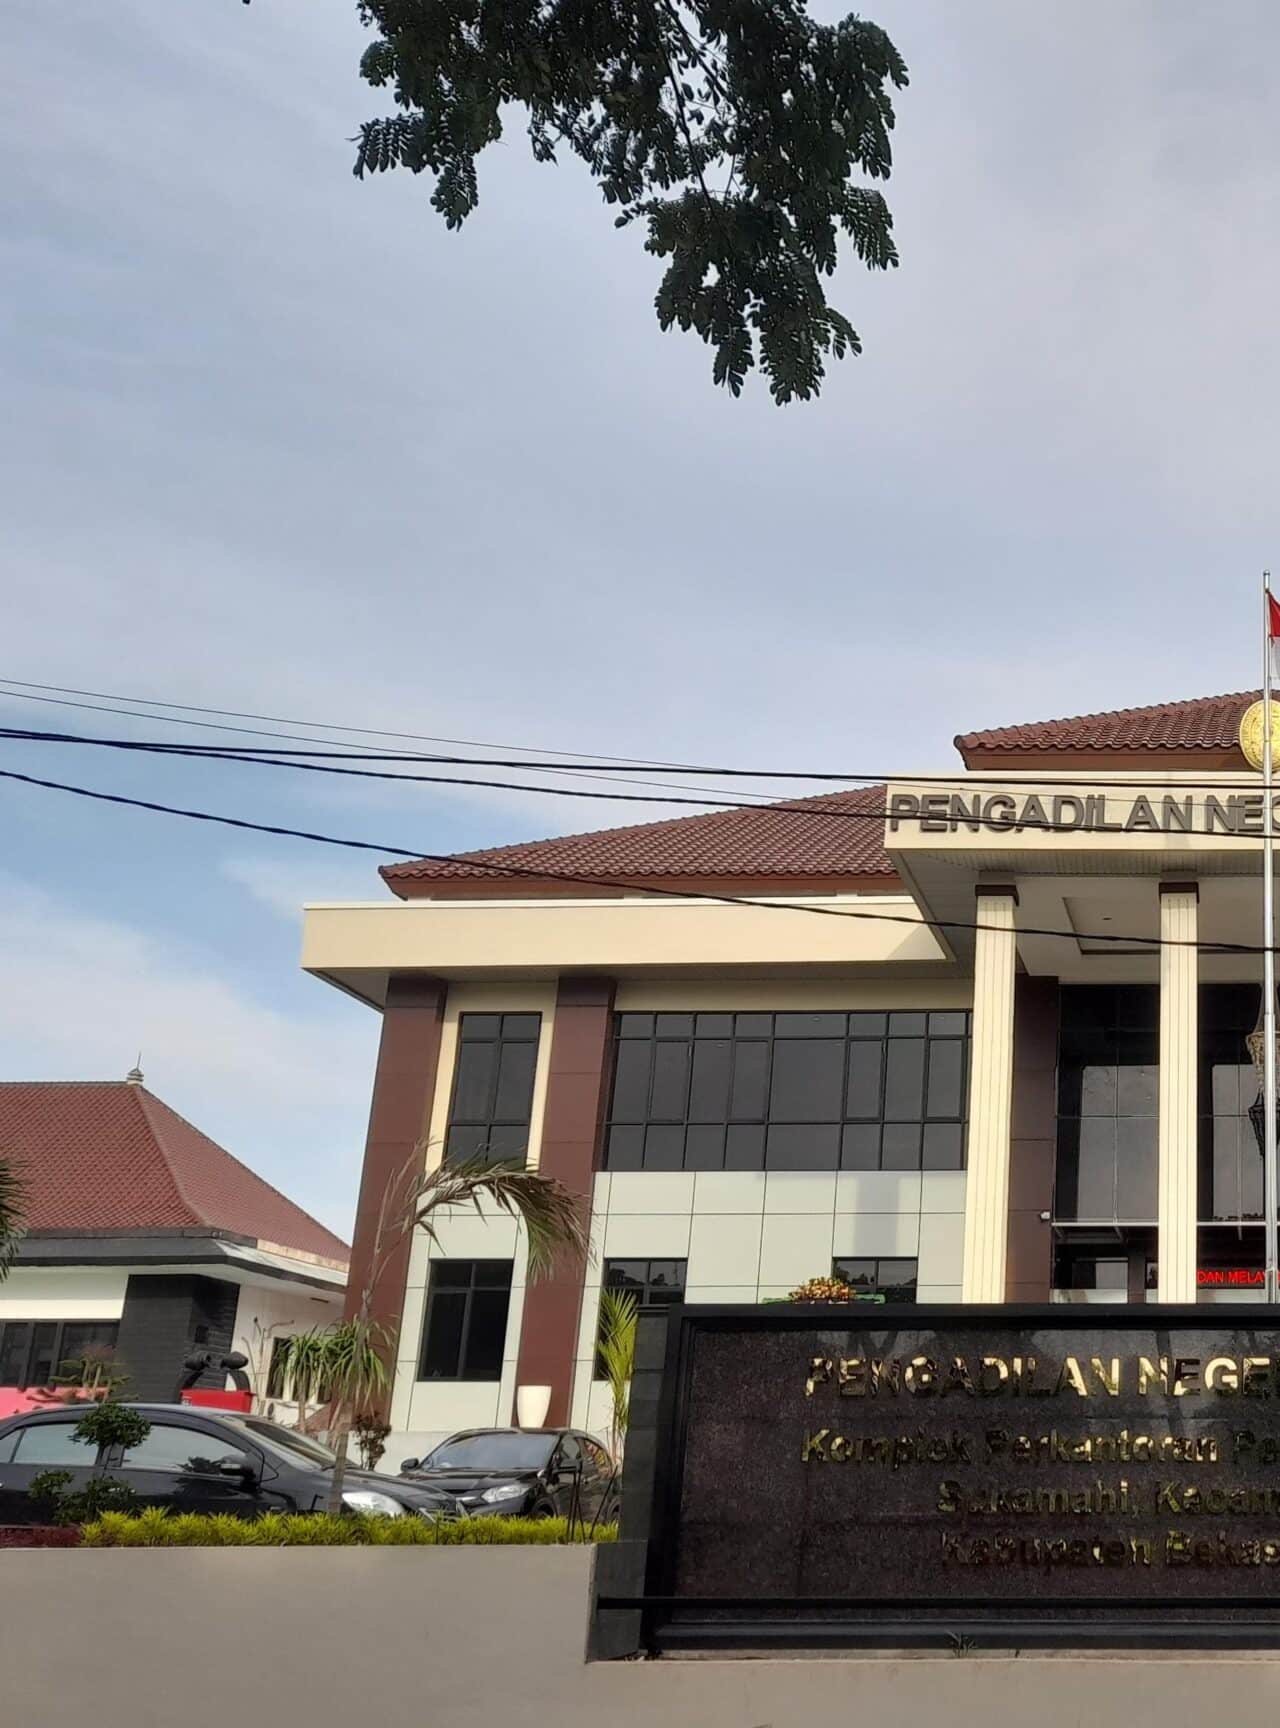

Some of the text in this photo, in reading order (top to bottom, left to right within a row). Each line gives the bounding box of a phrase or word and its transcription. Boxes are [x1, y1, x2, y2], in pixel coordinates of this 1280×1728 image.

[889, 792, 1194, 834] PENGADILAN
[1197, 1270, 1224, 1284] DAN
[806, 1357, 1121, 1396] PENGADILAN
[800, 1429, 972, 1469] Komplek
[986, 1430, 1220, 1465] Perkantoran
[939, 1531, 1152, 1571] Kabupaten
